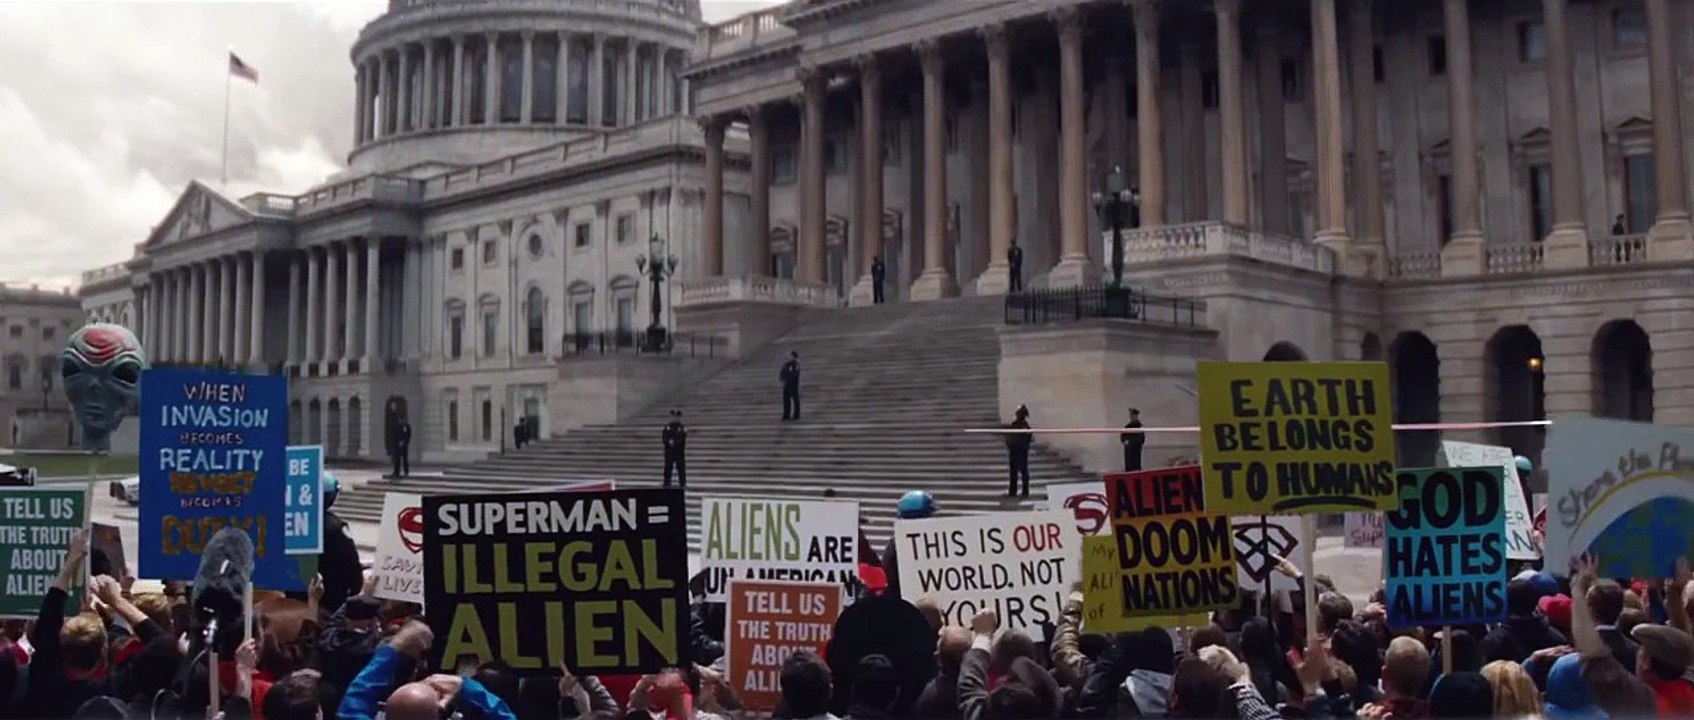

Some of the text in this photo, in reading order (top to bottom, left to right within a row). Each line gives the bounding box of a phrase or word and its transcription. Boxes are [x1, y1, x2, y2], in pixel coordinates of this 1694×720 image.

[184, 382, 245, 402] WHEN
[1231, 378, 1376, 417] EARTH
[161, 405, 269, 428] INVASION
[180, 432, 244, 445] BECOMES
[1213, 418, 1375, 452] BELONGS
[160, 448, 264, 472] REALITY
[289, 458, 310, 476] BE
[1115, 473, 1204, 518] ALIEN
[1212, 461, 1395, 500] TO HUMANS
[4, 497, 74, 519] TELL US
[438, 499, 638, 536] SUPERMAN
[1387, 471, 1500, 530] GOD
[0, 526, 26, 544] THE
[706, 502, 853, 562] ALIENS ARE
[907, 523, 1063, 560] THIS IS OUR
[1115, 515, 1231, 569] DOOM
[11, 549, 67, 571] ABOUT
[442, 538, 675, 594] ILLEGAL
[1389, 533, 1502, 578] HATES
[918, 558, 1065, 592] WORLD. NOT
[1122, 566, 1237, 610] NATIONS
[745, 591, 825, 615] TELL US
[1391, 581, 1504, 622] ALIENS
[440, 598, 679, 671] ALIEN
[737, 620, 832, 642] THE TRUTH
[751, 645, 817, 666] ABO
